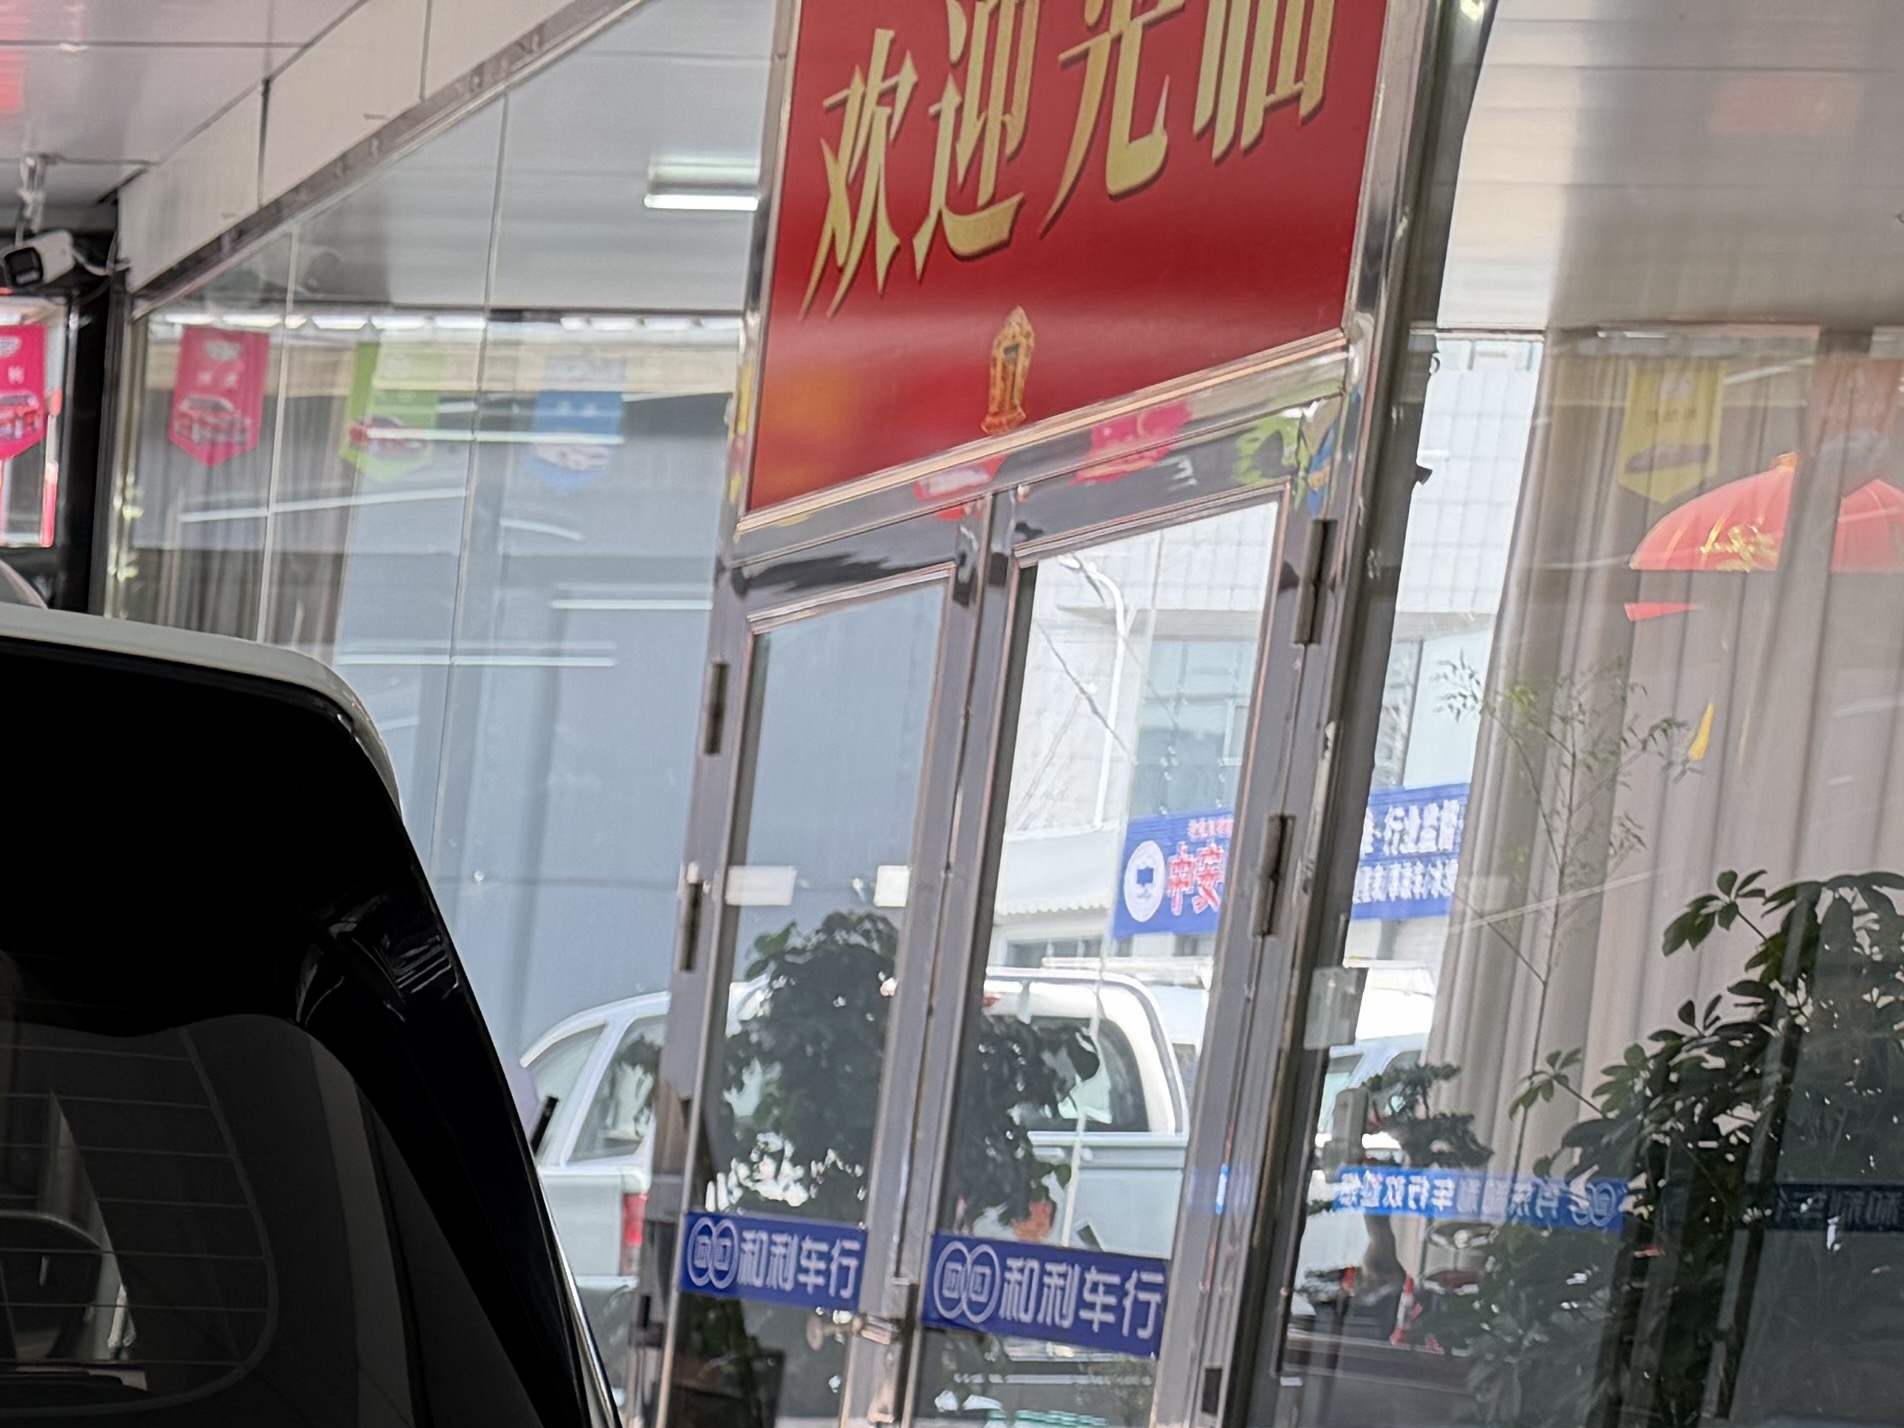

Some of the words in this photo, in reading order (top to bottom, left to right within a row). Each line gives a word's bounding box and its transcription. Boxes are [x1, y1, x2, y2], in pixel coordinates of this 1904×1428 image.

[738, 1229, 862, 1300] 和利车行
[1000, 1256, 1167, 1340] 和利车行
